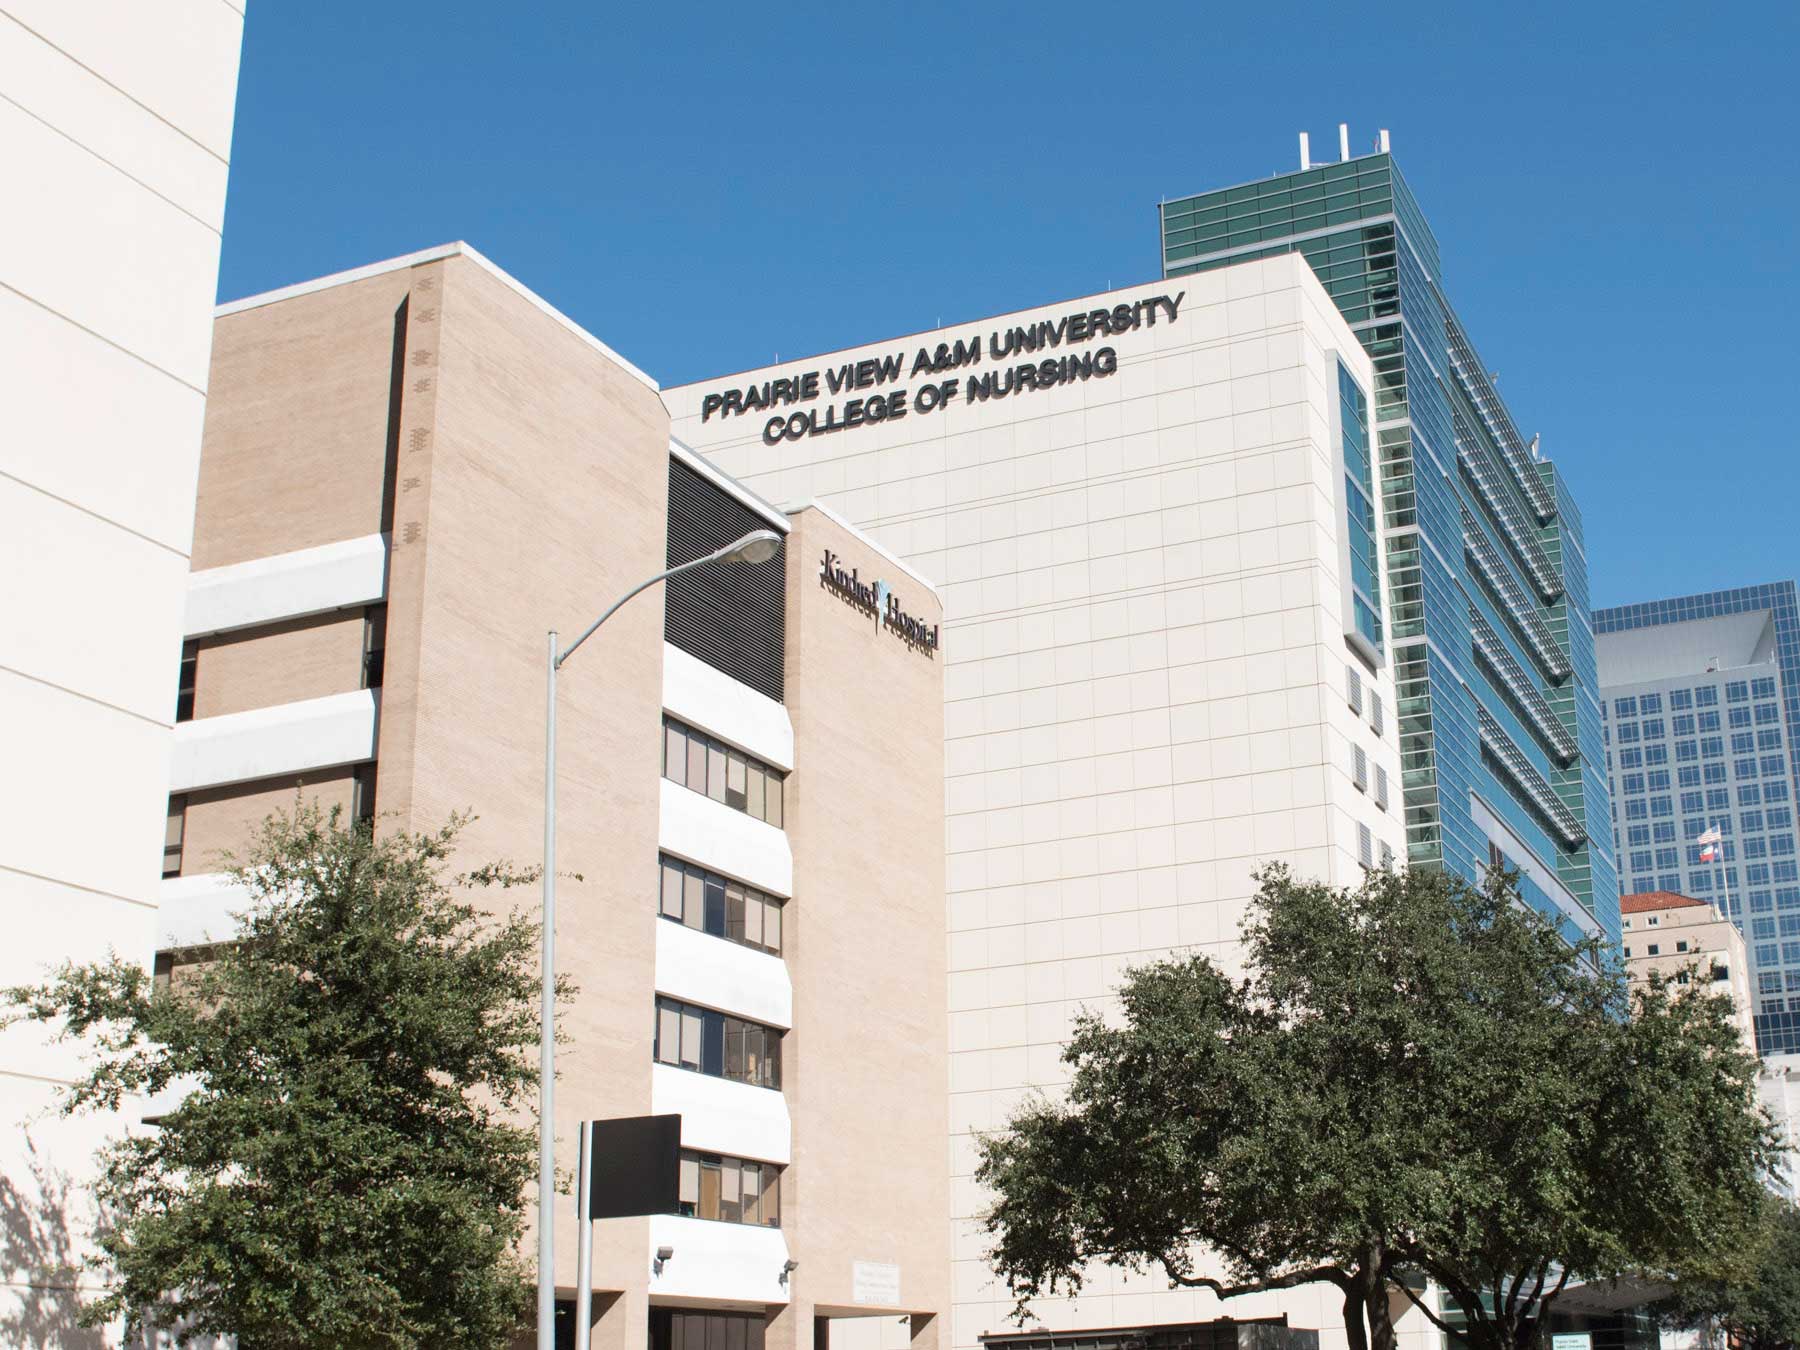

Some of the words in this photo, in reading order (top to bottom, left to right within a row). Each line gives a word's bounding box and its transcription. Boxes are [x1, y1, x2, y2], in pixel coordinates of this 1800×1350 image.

[702, 371, 820, 421] PRAIRIE
[825, 352, 905, 391] VIEW
[911, 336, 981, 377] A&M
[990, 291, 1185, 361] UNIVERSITY
[762, 389, 908, 444] COLLEGE
[914, 379, 960, 413] OF
[966, 346, 1118, 403] NURSING
[820, 549, 879, 611] Kindred
[883, 592, 939, 650] Hospital
